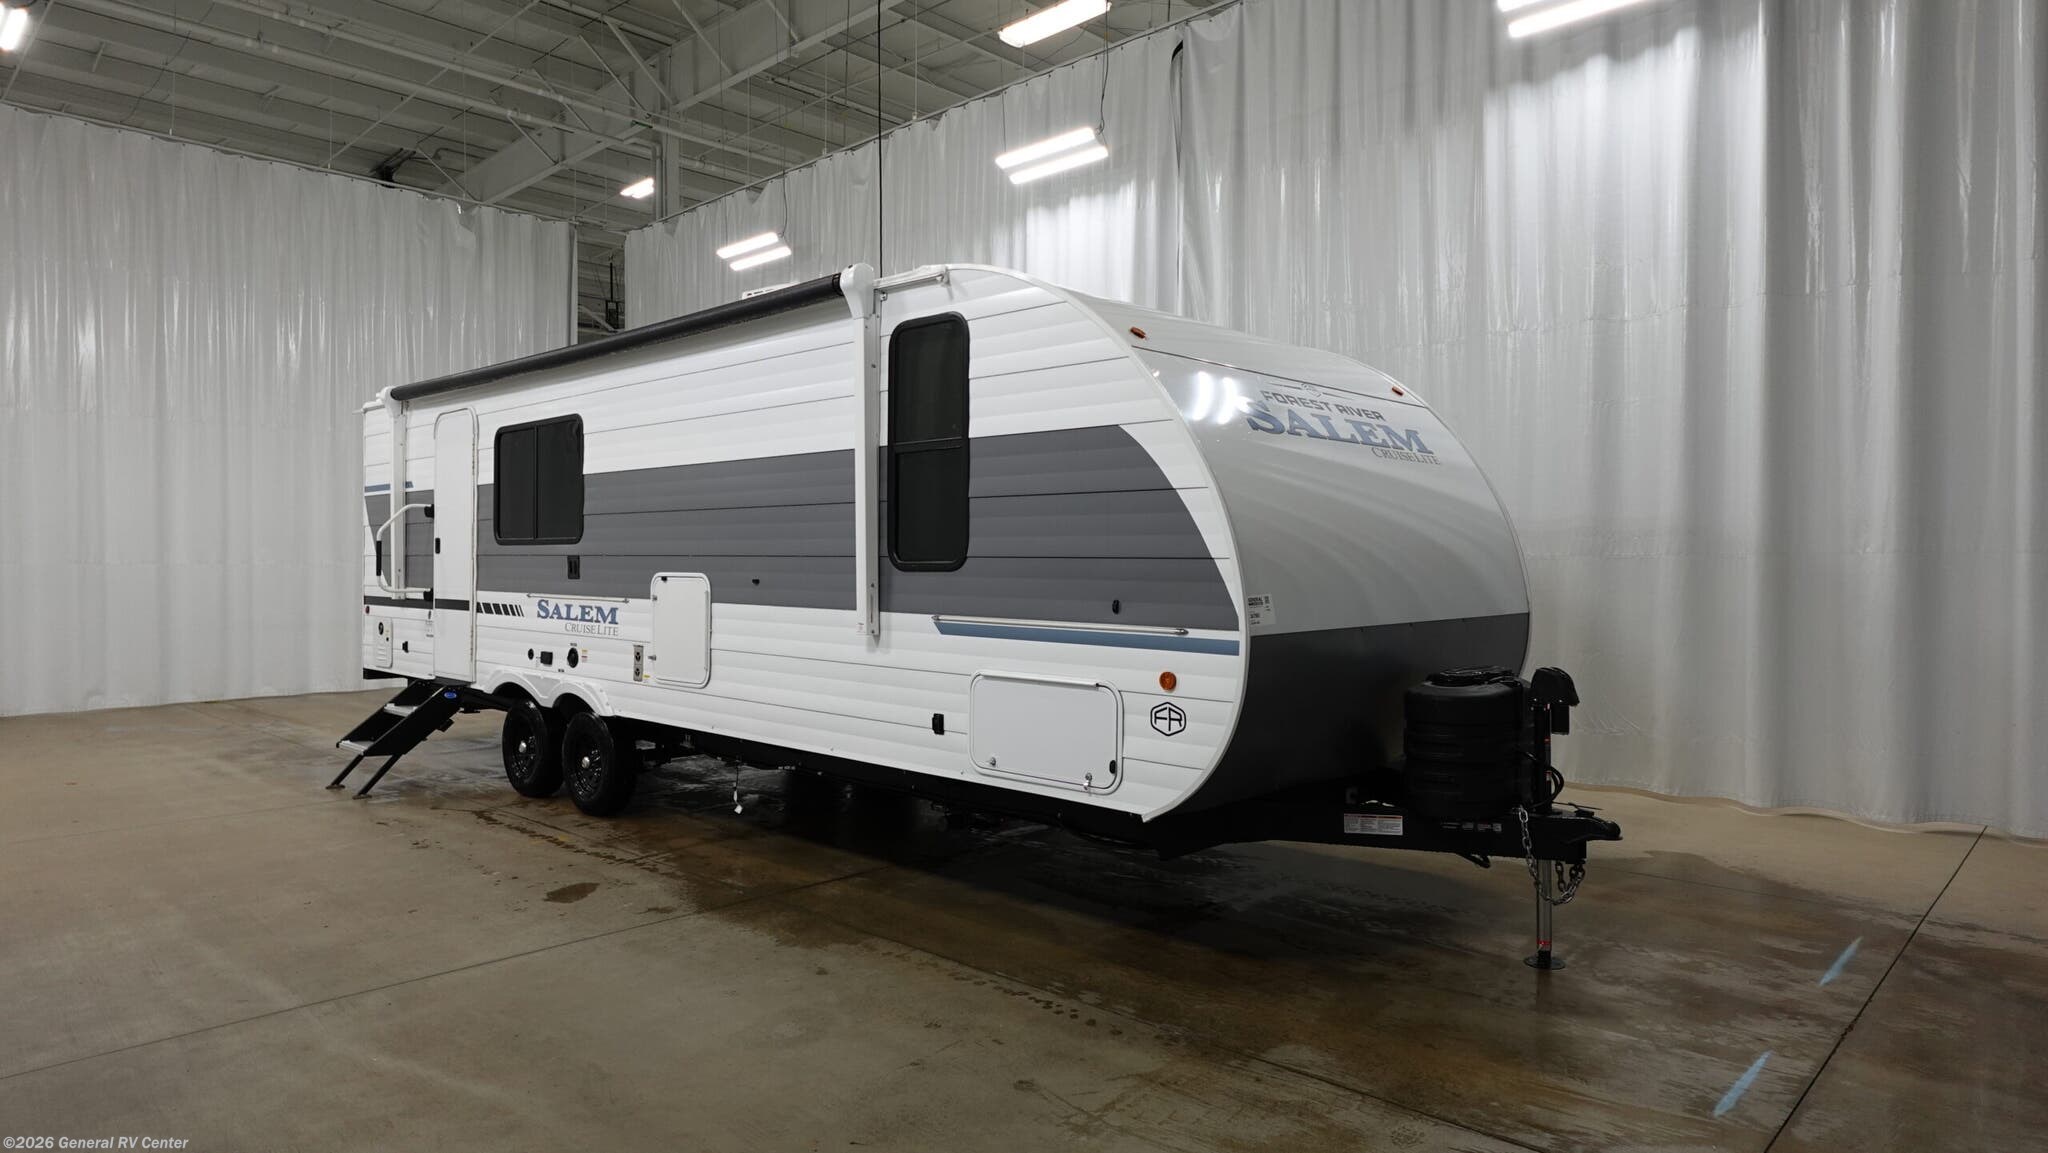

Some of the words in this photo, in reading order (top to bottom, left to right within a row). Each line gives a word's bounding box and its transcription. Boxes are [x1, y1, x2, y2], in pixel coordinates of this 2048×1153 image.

[1260, 390, 1332, 412] FOREST
[1333, 403, 1386, 421] RIVER
[1246, 400, 1434, 454] SALEM
[537, 599, 619, 625] SALEM
[1153, 706, 1183, 732] FR
